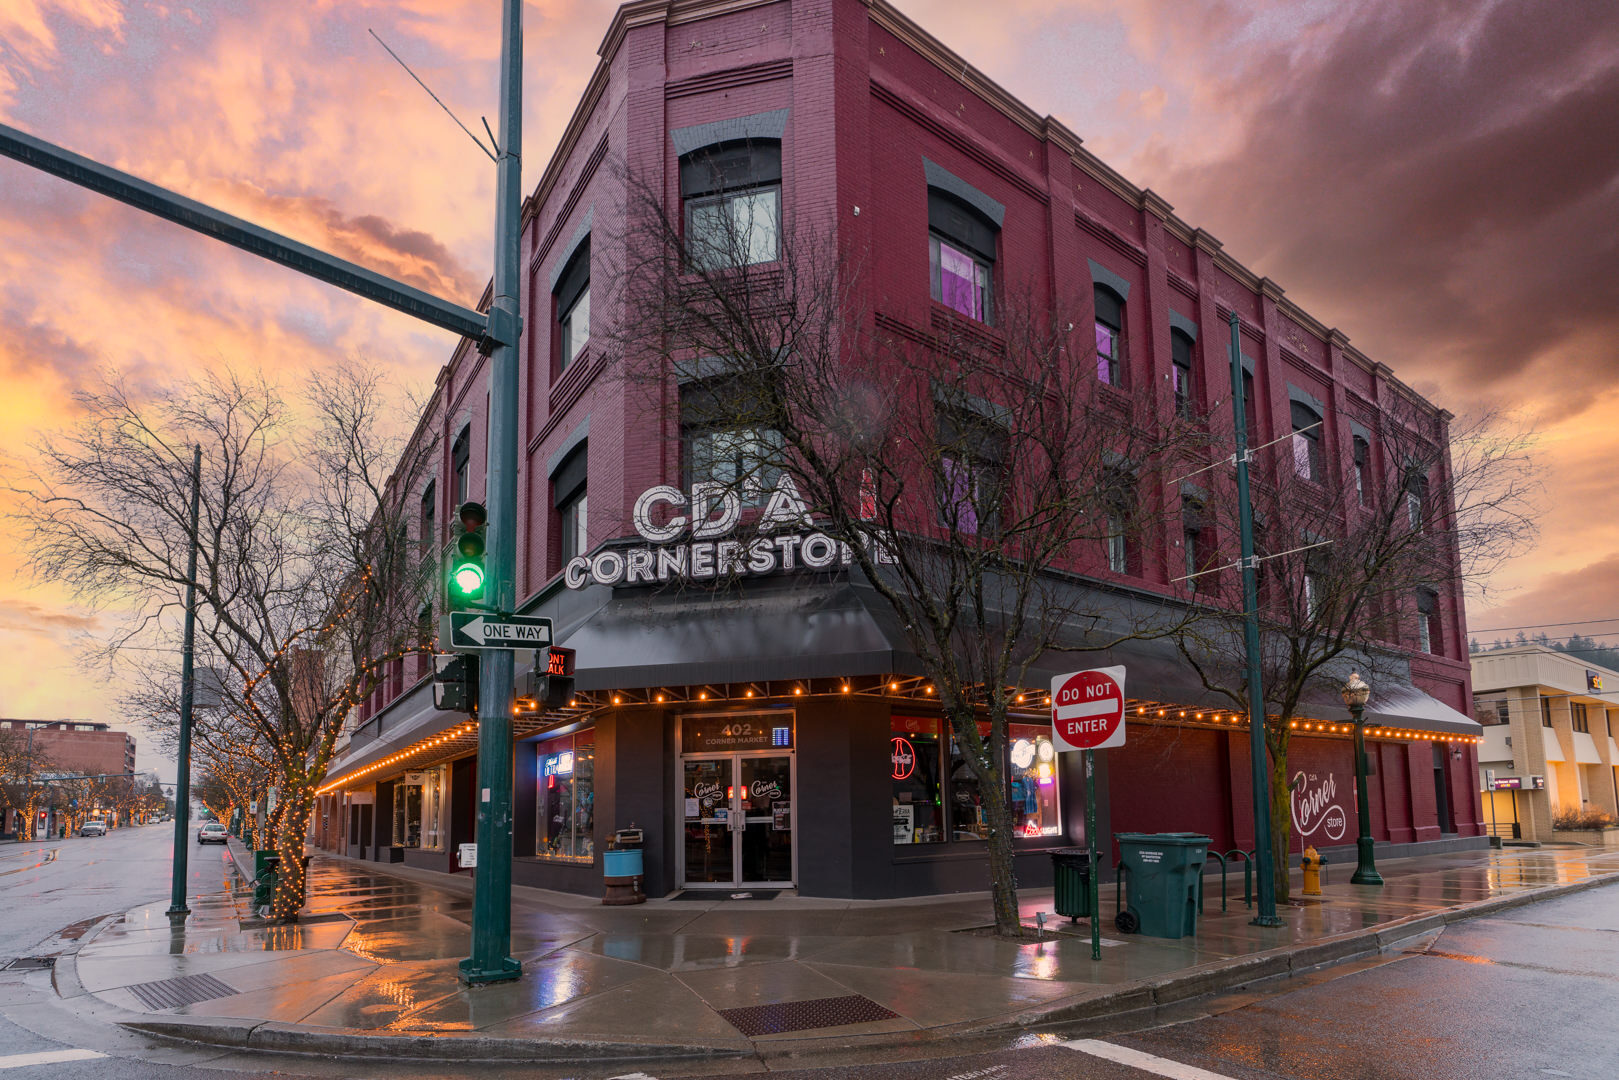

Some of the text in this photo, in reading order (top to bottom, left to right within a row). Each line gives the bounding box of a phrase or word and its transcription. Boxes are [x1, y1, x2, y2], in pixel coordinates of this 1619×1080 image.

[483, 624, 542, 639] ONE WAY
[548, 653, 565, 664] ONT
[548, 664, 565, 675] ALK
[1062, 682, 1112, 702] DO NOT
[721, 723, 752, 736] 402
[1067, 719, 1108, 735] ENTER
[705, 737, 736, 745] CORNER
[1291, 771, 1337, 836] Corner
[1326, 816, 1343, 828] store
